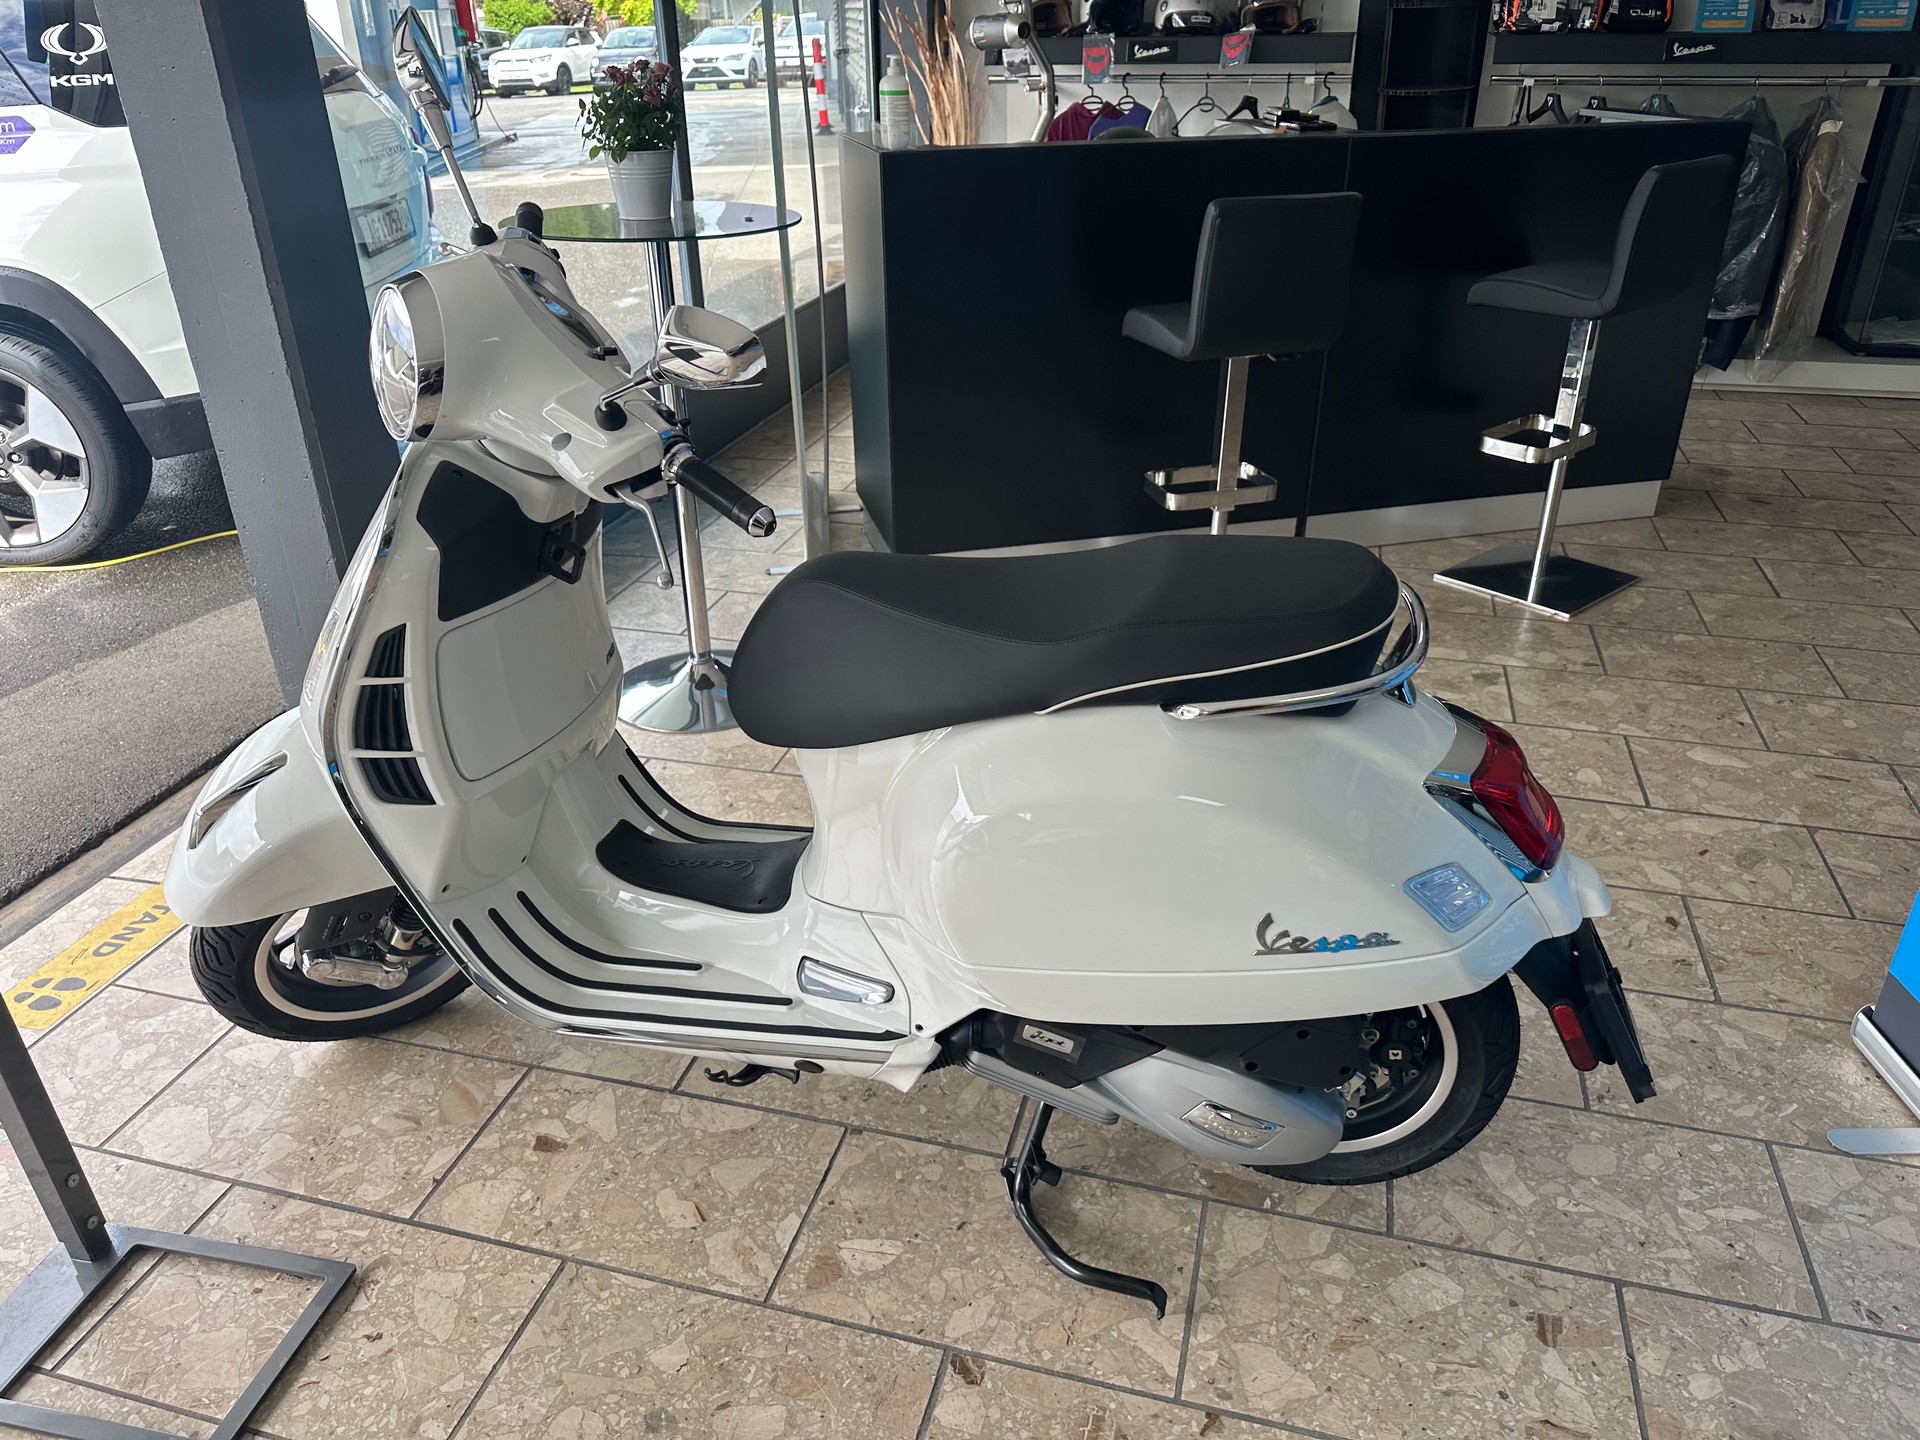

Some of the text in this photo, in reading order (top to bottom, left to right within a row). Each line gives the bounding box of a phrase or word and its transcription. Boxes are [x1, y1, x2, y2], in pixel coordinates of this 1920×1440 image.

[1134, 44, 1170, 59] Vespa
[1673, 41, 1717, 57] Vespa
[50, 73, 114, 88] KGM
[1252, 912, 1400, 956] Vespa
